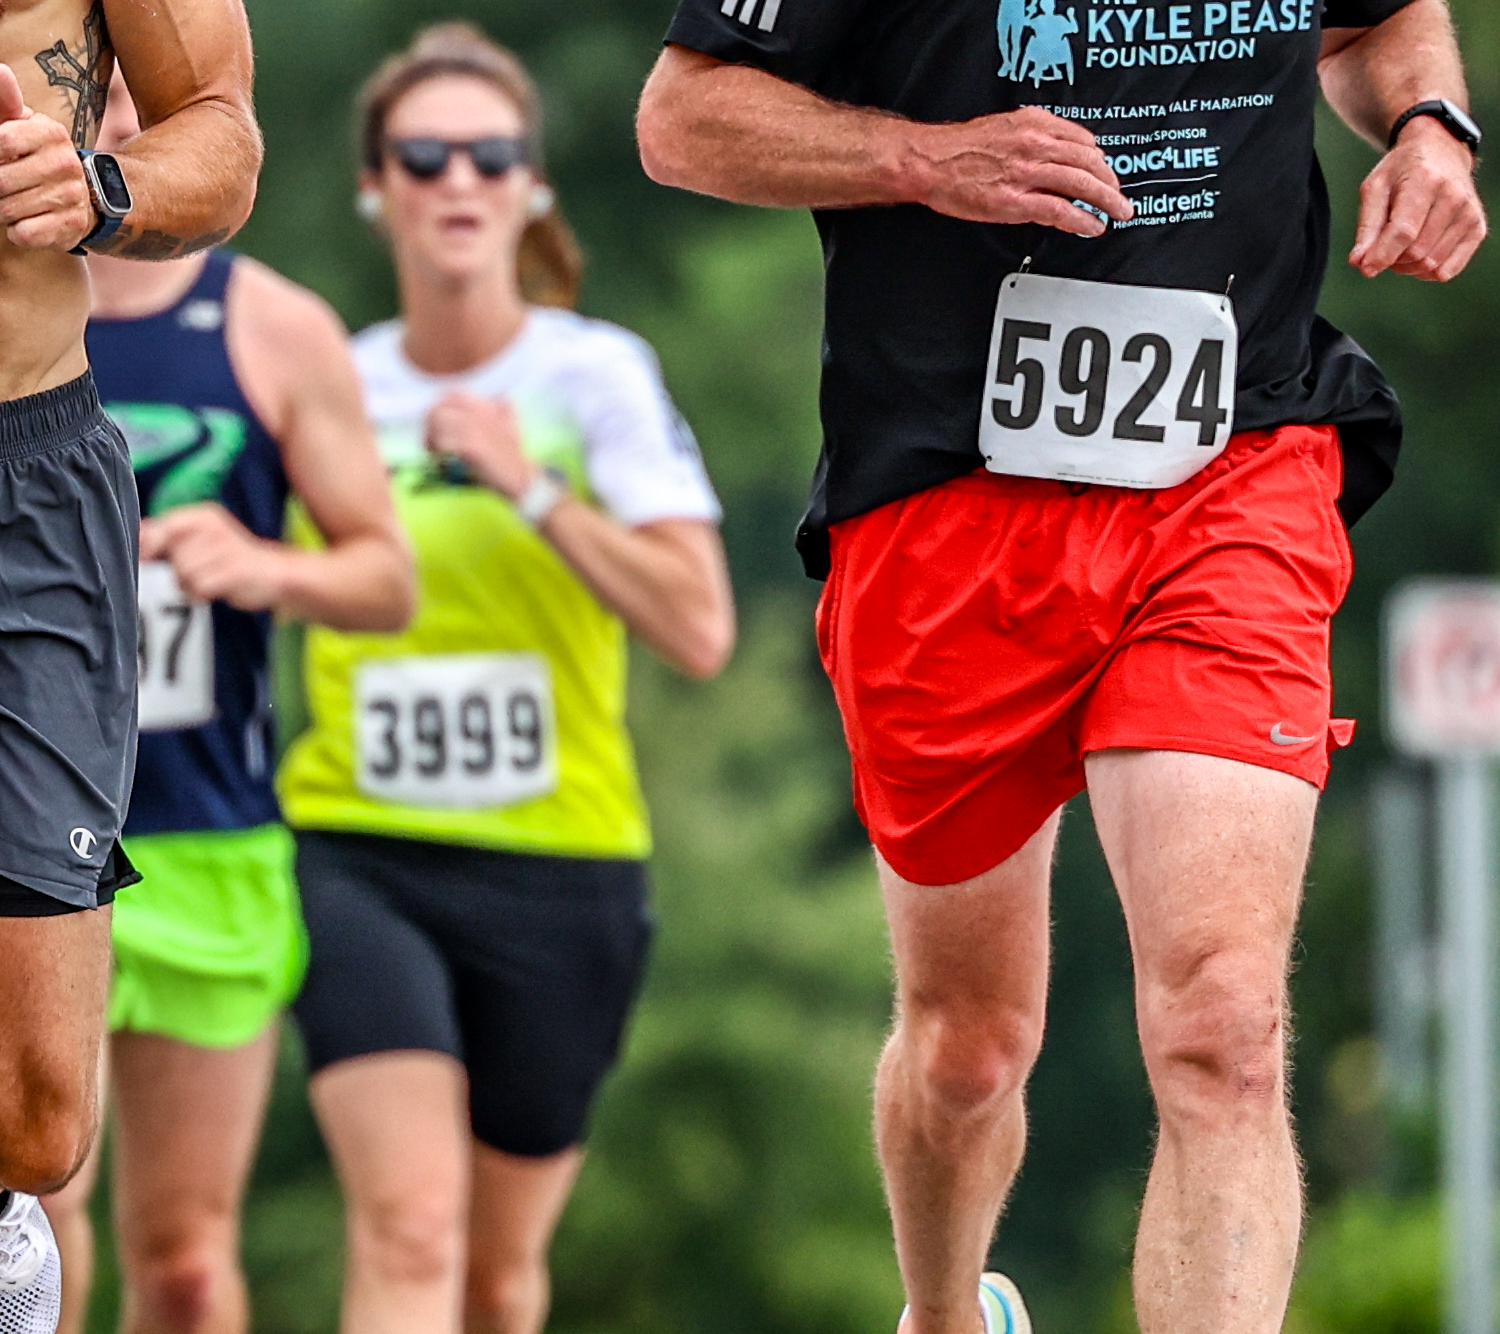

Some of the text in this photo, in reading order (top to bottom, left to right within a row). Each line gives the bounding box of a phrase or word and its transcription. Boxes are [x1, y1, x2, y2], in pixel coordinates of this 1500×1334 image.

[1087, 5, 1193, 43] KYLE
[1086, 37, 1257, 68] FOUNDATION
[1054, 105, 1103, 119] PUBLIX
[1104, 104, 1167, 119] ATLANTA
[1200, 94, 1275, 112] MARATHON
[1095, 128, 1207, 146] RESENTIN SPONSOR
[1128, 189, 1215, 216] hildren's
[1169, 213, 1181, 224] of
[991, 318, 1228, 447] 5924
[368, 691, 543, 779] 3999
